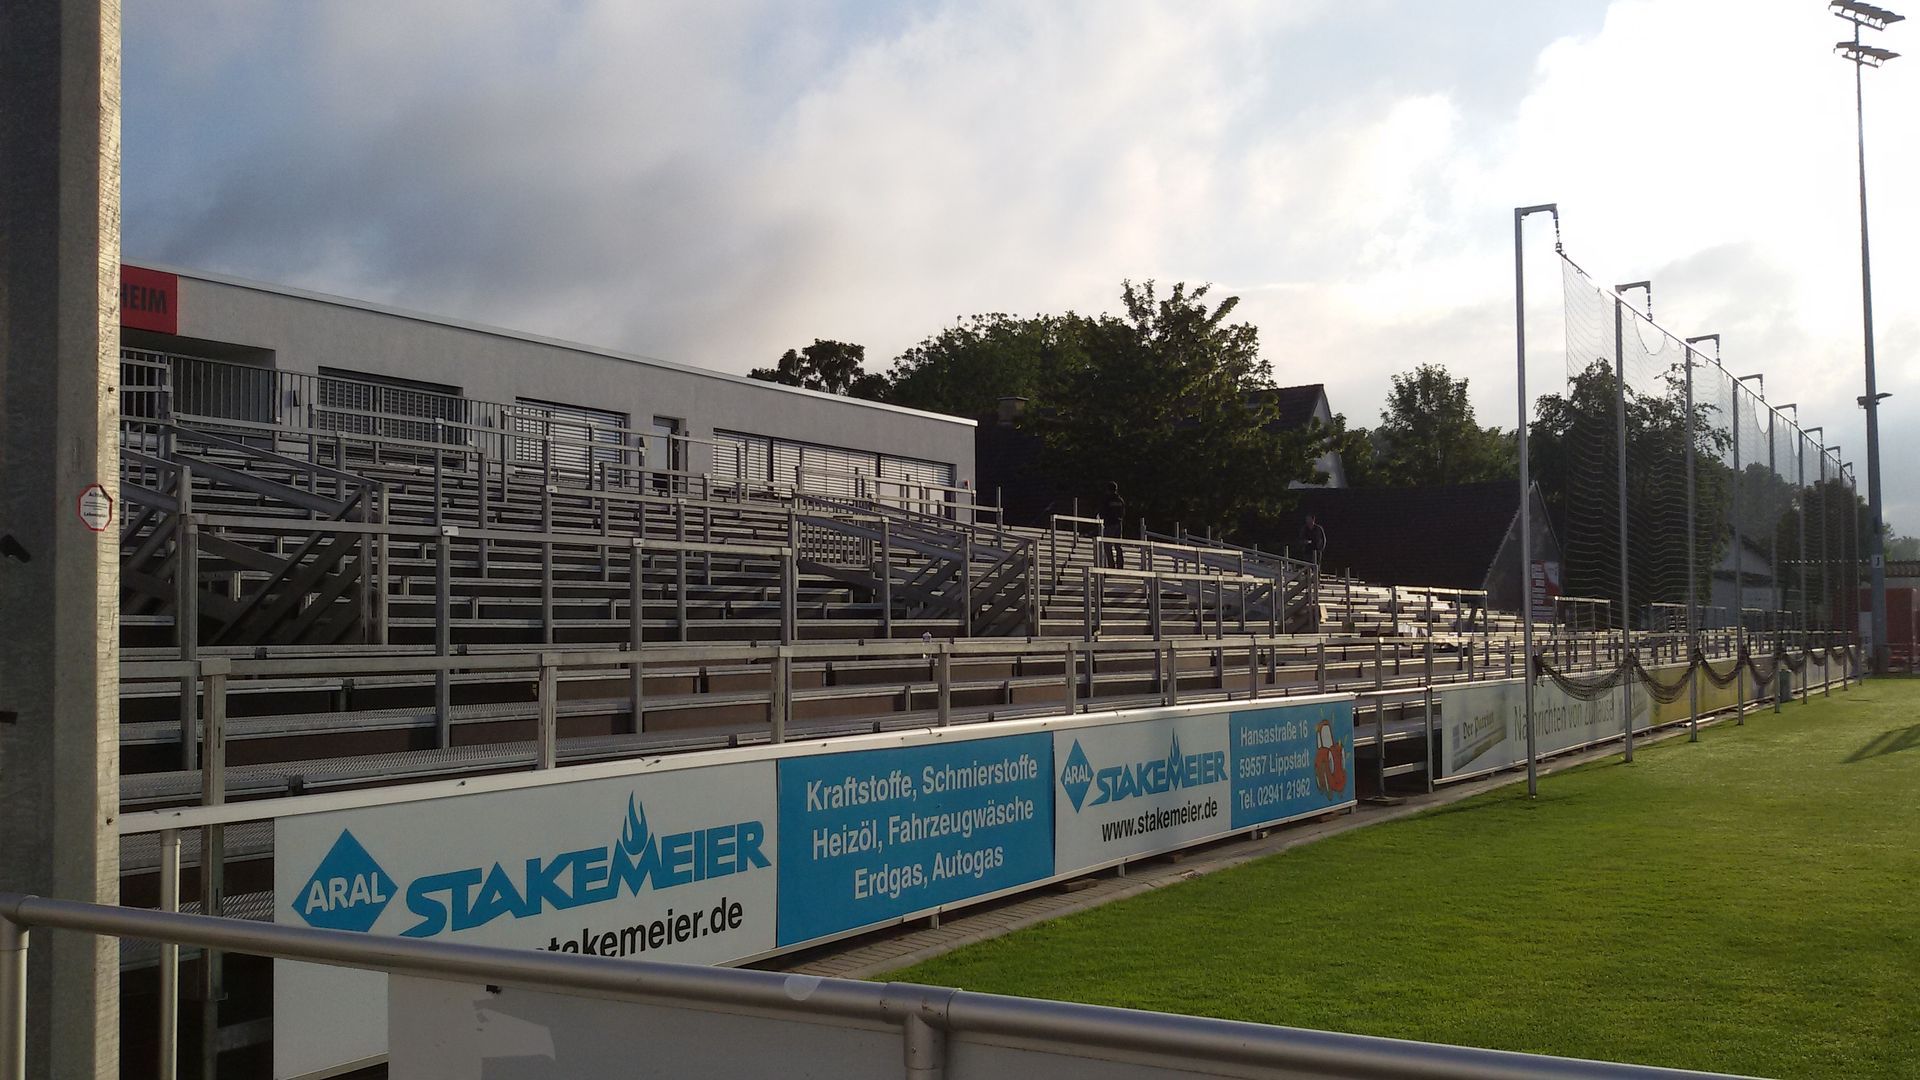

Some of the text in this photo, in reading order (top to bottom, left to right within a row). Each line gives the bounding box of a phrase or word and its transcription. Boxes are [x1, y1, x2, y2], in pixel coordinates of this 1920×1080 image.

[1240, 719, 1308, 747] Hansastraße 16
[1514, 696, 1567, 741] Narichten
[807, 753, 1038, 812] Kraftstoffe, Schmierstoffe
[1064, 763, 1090, 784] ARAL
[1088, 750, 1228, 807] STAKEMEIER
[1239, 748, 1310, 778] 59557 Lippstadt
[1239, 777, 1311, 810] Tel. 02941 21962
[812, 795, 1034, 861] Heizöl, Fahrzeugwäsche
[1102, 796, 1218, 842] www.stakemeier.de
[305, 871, 387, 914] ARAL
[400, 820, 772, 938] STAKEMEIER
[854, 845, 1004, 900] Erdgas, Autogas
